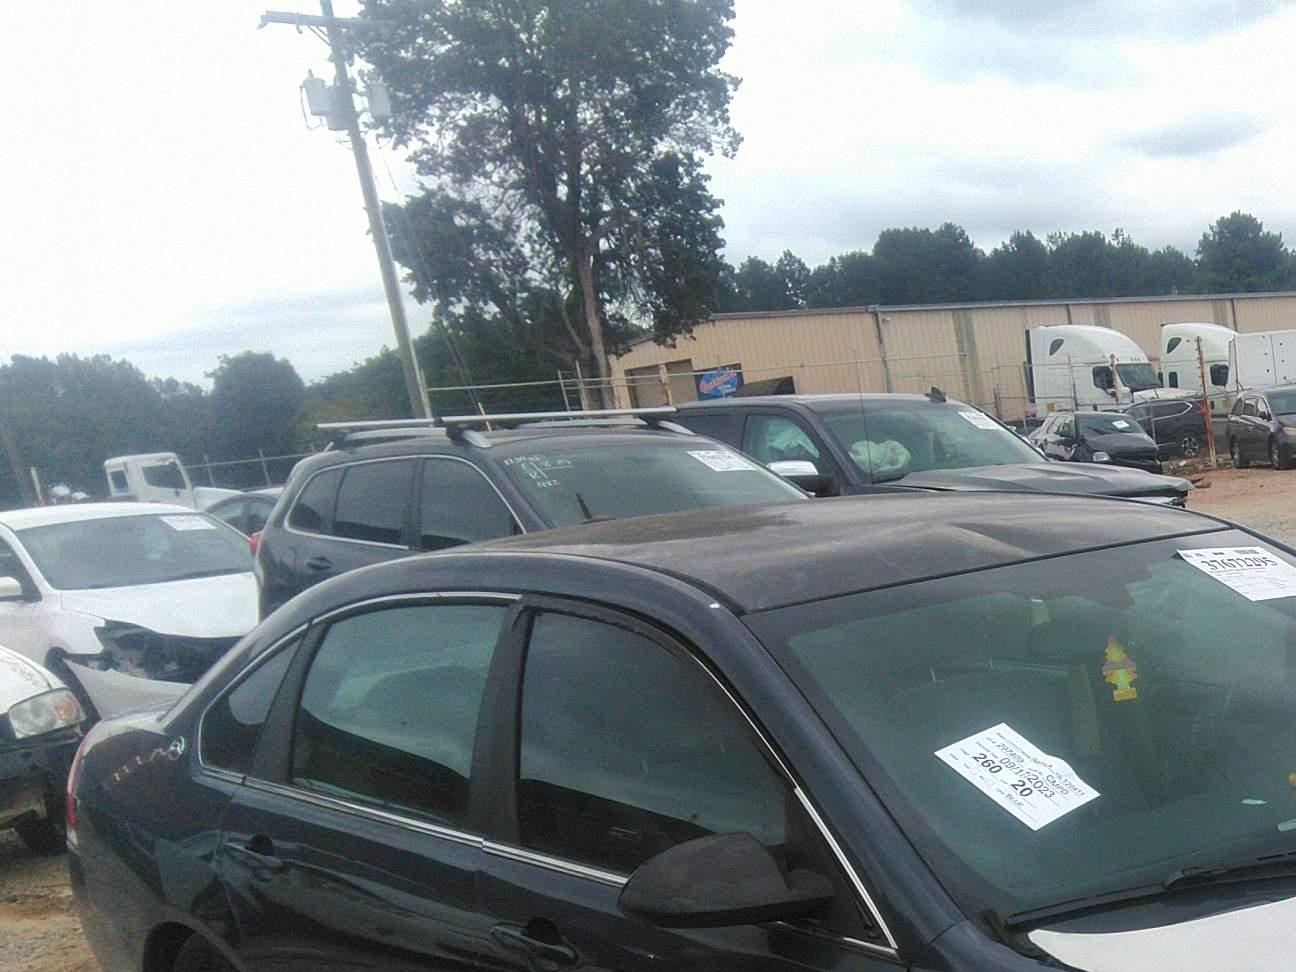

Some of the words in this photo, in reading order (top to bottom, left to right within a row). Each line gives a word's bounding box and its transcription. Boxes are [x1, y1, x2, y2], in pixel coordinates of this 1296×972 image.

[1201, 555, 1278, 571] 37672295
[972, 752, 1003, 774] 260
[1010, 779, 1034, 798] 20
[1045, 773, 1070, 796] CMPD
